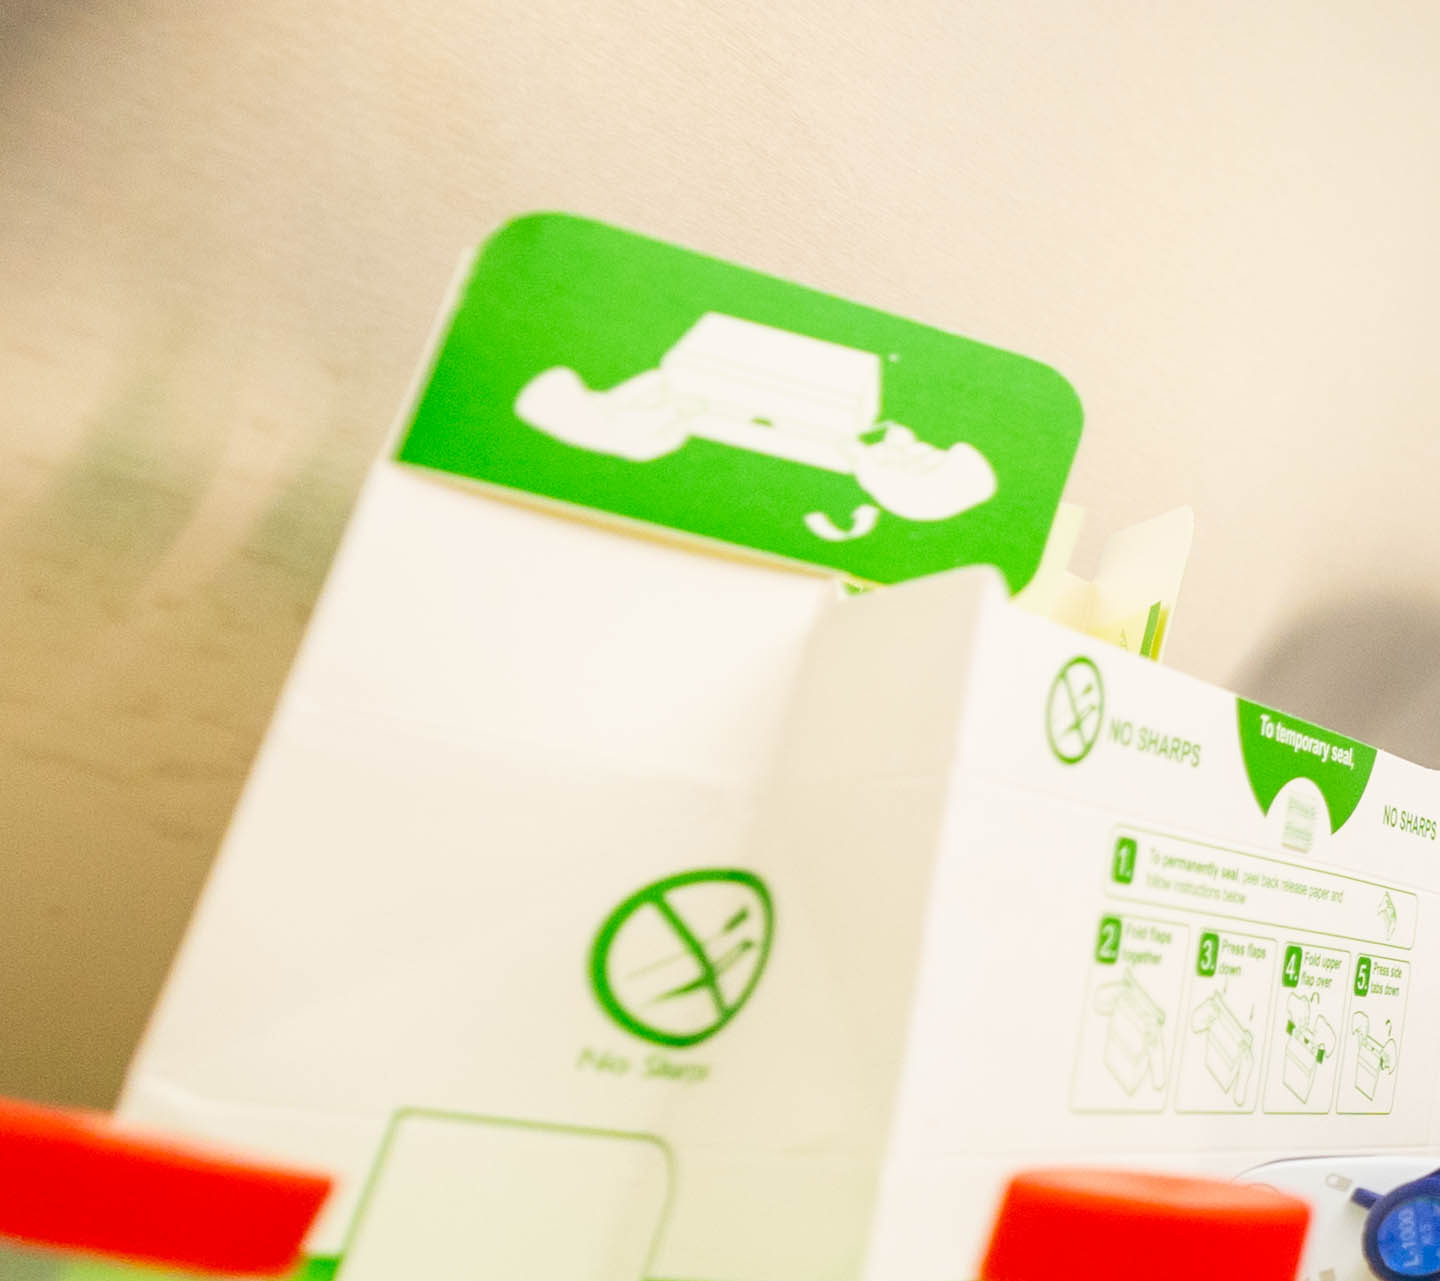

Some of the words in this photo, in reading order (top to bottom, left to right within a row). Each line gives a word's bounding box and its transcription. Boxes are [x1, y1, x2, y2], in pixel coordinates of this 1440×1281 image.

[1109, 716, 1133, 747] NO
[1137, 725, 1201, 769] SHARPS
[1259, 713, 1275, 739] To
[1276, 722, 1330, 763] temporary
[1383, 804, 1398, 828] NO
[1399, 810, 1437, 841] SHARPS
[1162, 854, 1219, 880] permanently
[1309, 885, 1330, 902] paper
[1222, 938, 1245, 957] Press
[1247, 942, 1267, 960] flaps
[1219, 963, 1242, 977] down
[1284, 953, 1298, 982] 4.
[1304, 951, 1321, 968] Fold
[1322, 955, 1342, 974] upper
[1373, 961, 1390, 977] Press
[1391, 966, 1402, 979] side
[1302, 971, 1315, 988] flap
[1316, 976, 1333, 988] over
[1356, 963, 1368, 991] 5.
[1370, 982, 1383, 995] tabs
[1384, 984, 1400, 997] down
